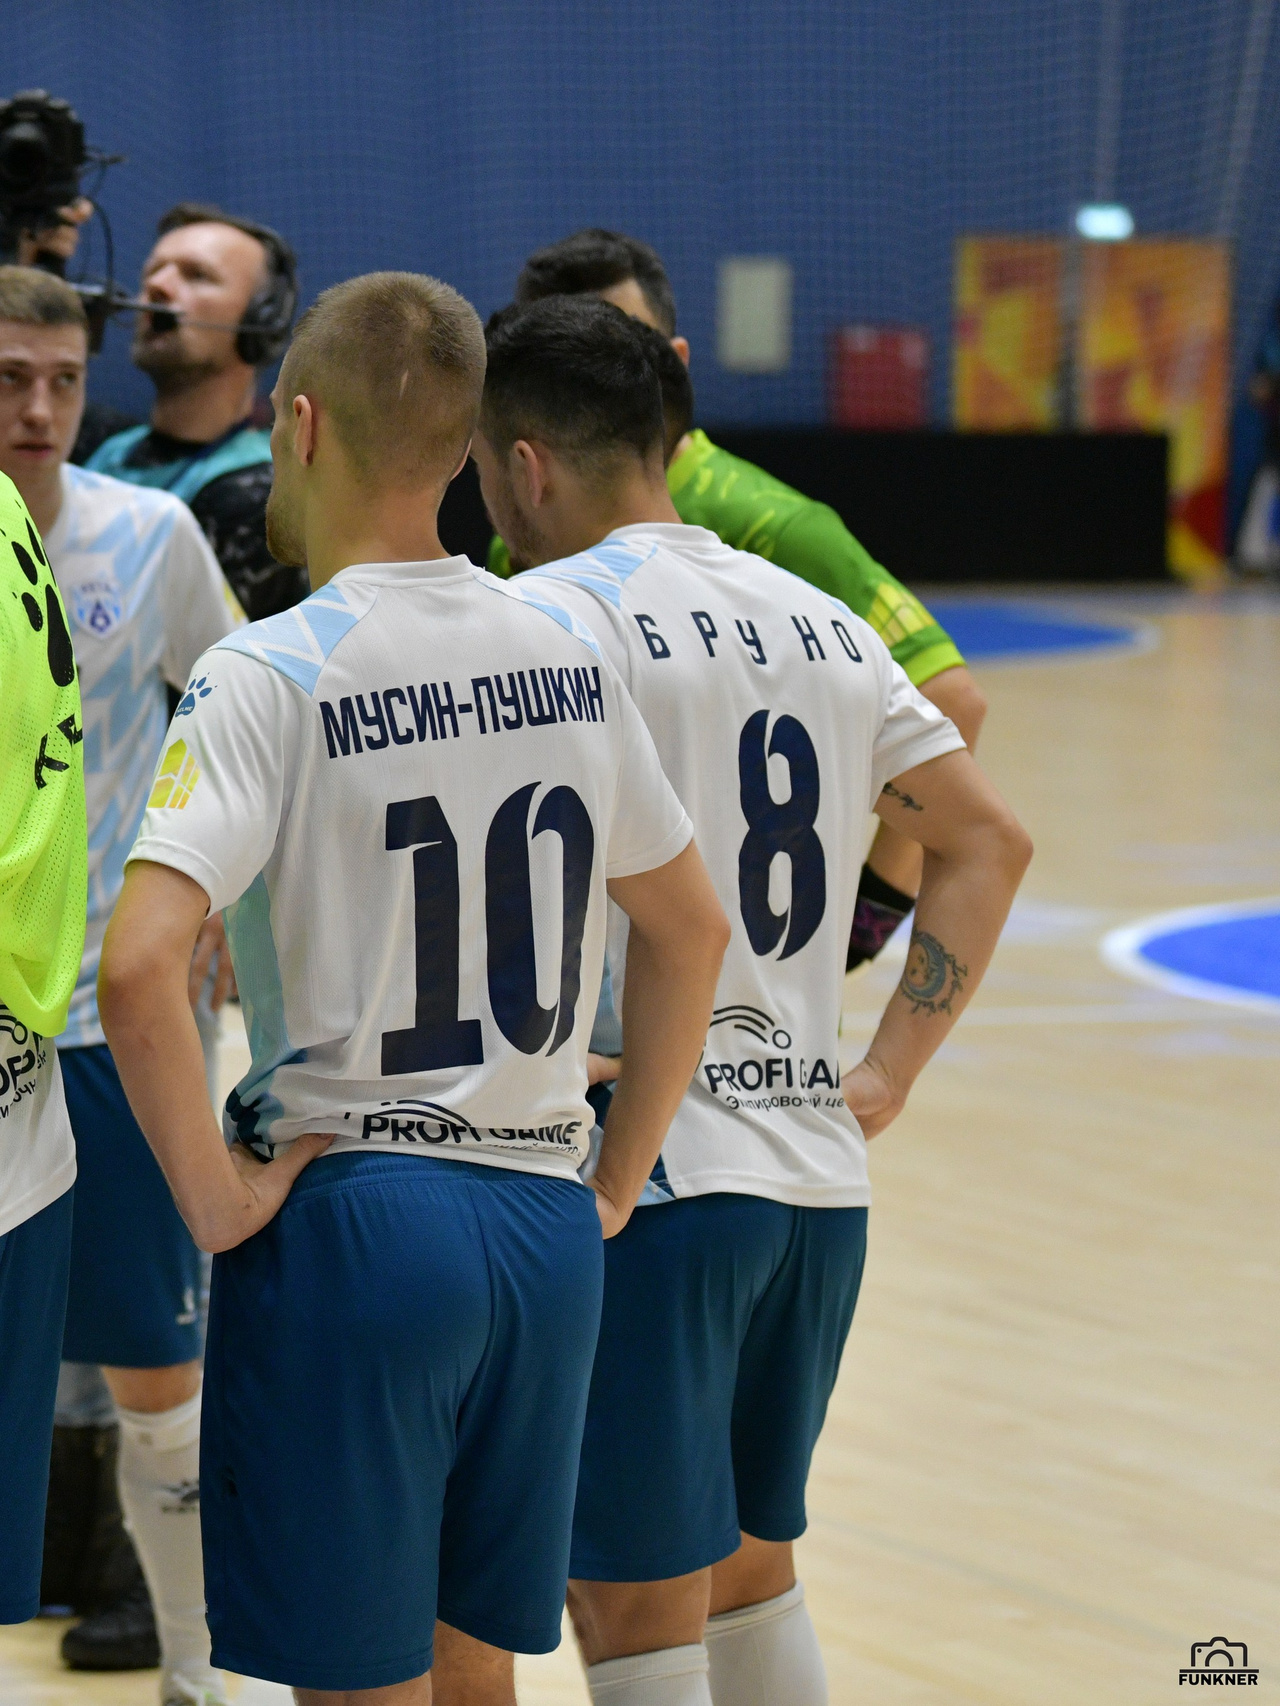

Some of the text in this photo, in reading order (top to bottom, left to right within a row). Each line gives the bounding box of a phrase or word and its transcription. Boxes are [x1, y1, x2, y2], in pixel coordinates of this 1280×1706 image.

[634, 610, 863, 665] БРУНО
[319, 666, 606, 759] МУСИН-ПУШКИН
[738, 709, 826, 961] 8
[381, 781, 595, 1076] 10
[704, 1058, 793, 1094] PROFI
